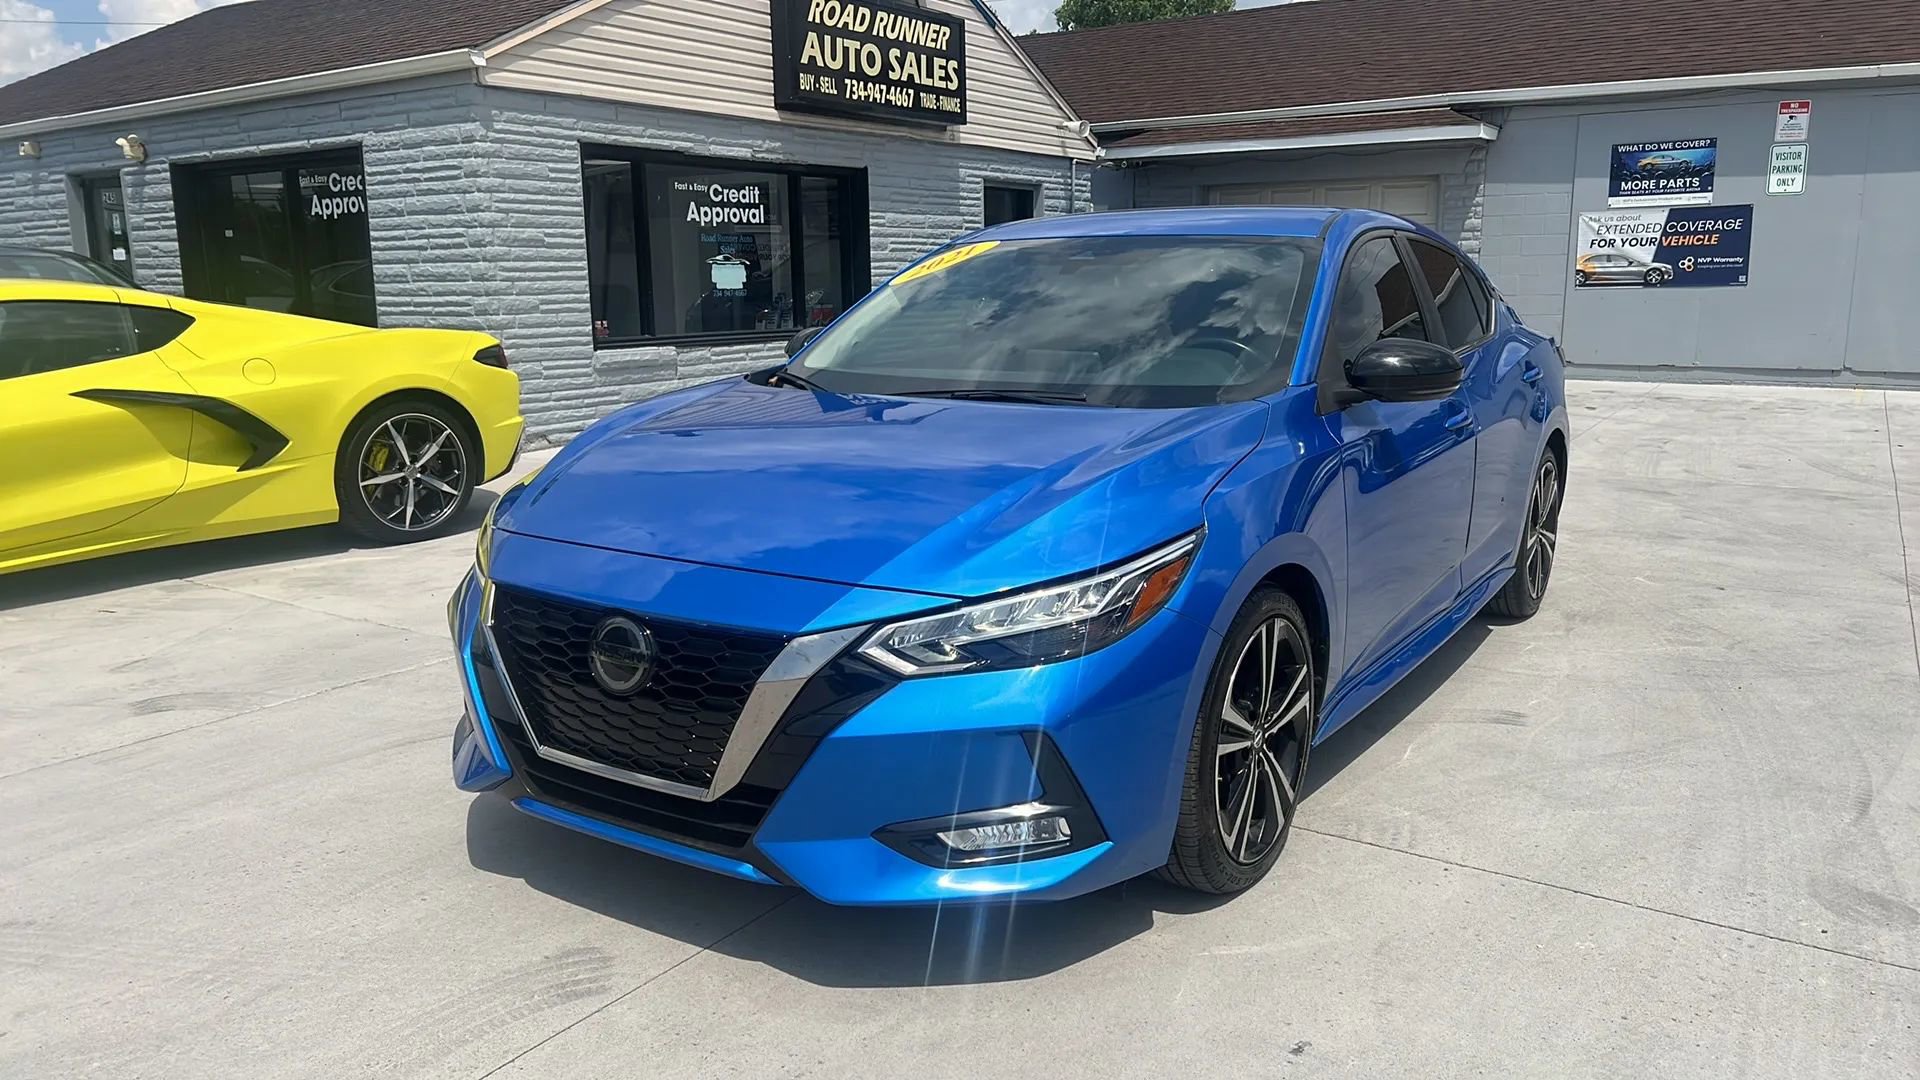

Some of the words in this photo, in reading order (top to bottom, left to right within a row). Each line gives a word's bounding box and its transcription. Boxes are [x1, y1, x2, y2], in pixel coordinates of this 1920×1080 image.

[808, 0, 871, 33] ROAD
[872, 10, 951, 50] RUNNER
[800, 31, 882, 77] AUTO
[888, 47, 959, 91] SALES
[844, 79, 914, 108] 734-947-4667
[1618, 144, 1643, 152] WHAT
[1645, 143, 1658, 151] DO
[1660, 142, 1674, 150] WE
[1675, 139, 1711, 149] COVER?
[1775, 151, 1802, 161] VISITOR
[1772, 164, 1803, 174] PARKING
[1620, 179, 1657, 191] MORE
[1659, 177, 1700, 189] PARTS
[1776, 177, 1796, 187] ONLY
[674, 181, 688, 191] Fast
[694, 182, 708, 193] Easy
[709, 183, 760, 204] Credit
[686, 201, 765, 227] Approval
[1587, 215, 1602, 223] Ask
[1616, 214, 1642, 222] about
[1596, 222, 1663, 236] EXTENDED
[1666, 218, 1744, 233] COVERAGE
[1589, 238, 1616, 249] FOR
[1620, 237, 1658, 248] YOUR
[1661, 234, 1720, 247] VEHICLE
